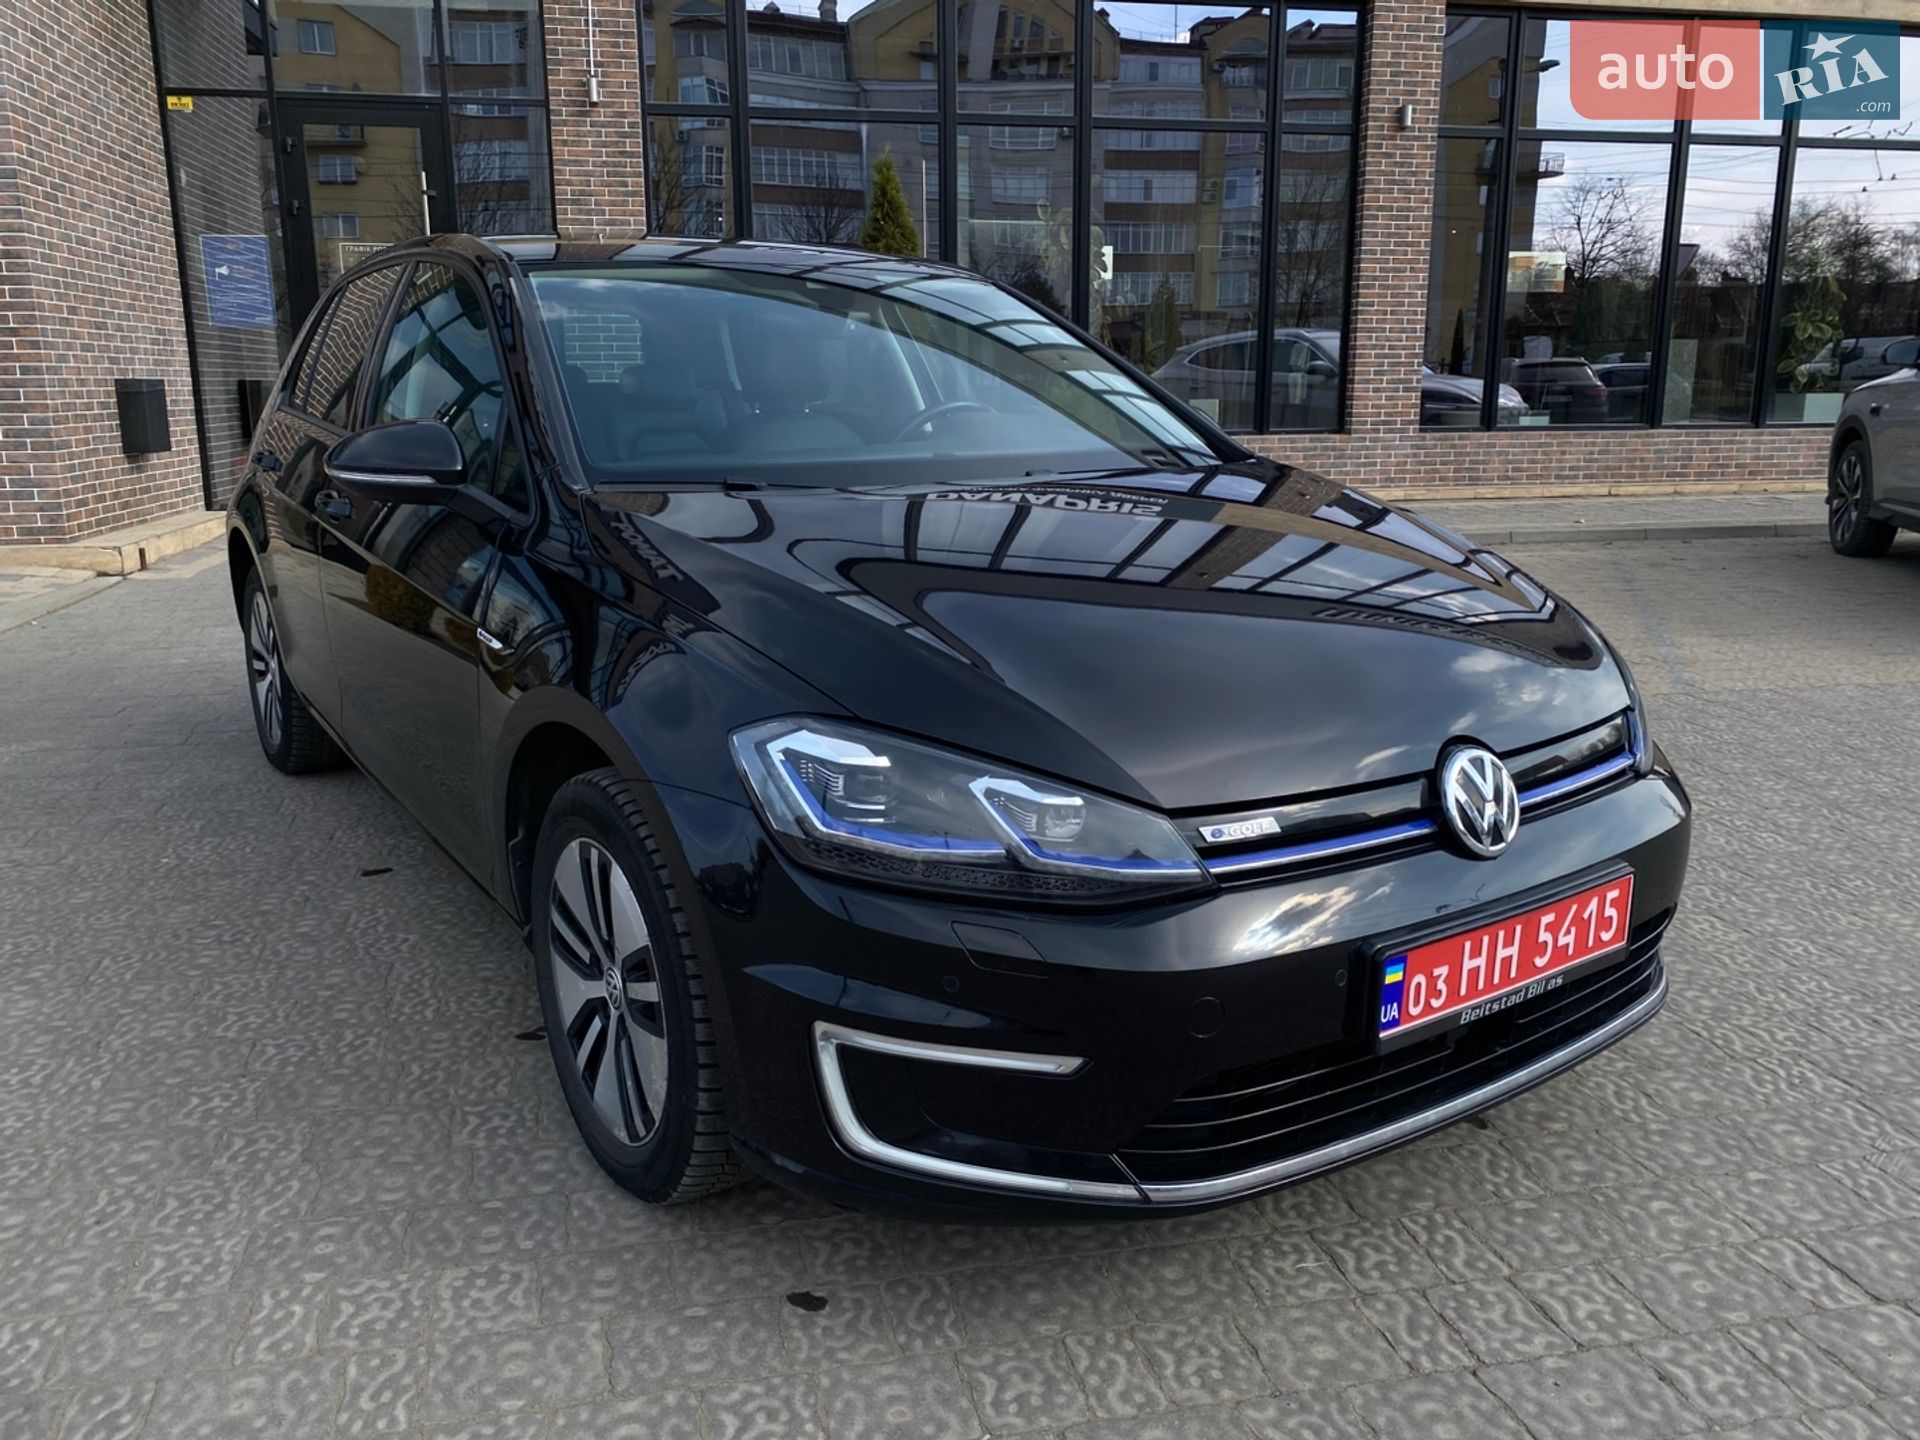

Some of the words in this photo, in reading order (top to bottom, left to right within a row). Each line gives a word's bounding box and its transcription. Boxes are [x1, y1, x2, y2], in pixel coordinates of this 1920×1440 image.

[1406, 964, 1450, 1017] 03
[1457, 924, 1523, 997] HH
[1532, 888, 1621, 968] 5415
[1380, 1001, 1400, 1023] UA
[1459, 988, 1526, 1025] Beitstad
[1527, 979, 1546, 1000] Bil
[1546, 973, 1565, 989] as
